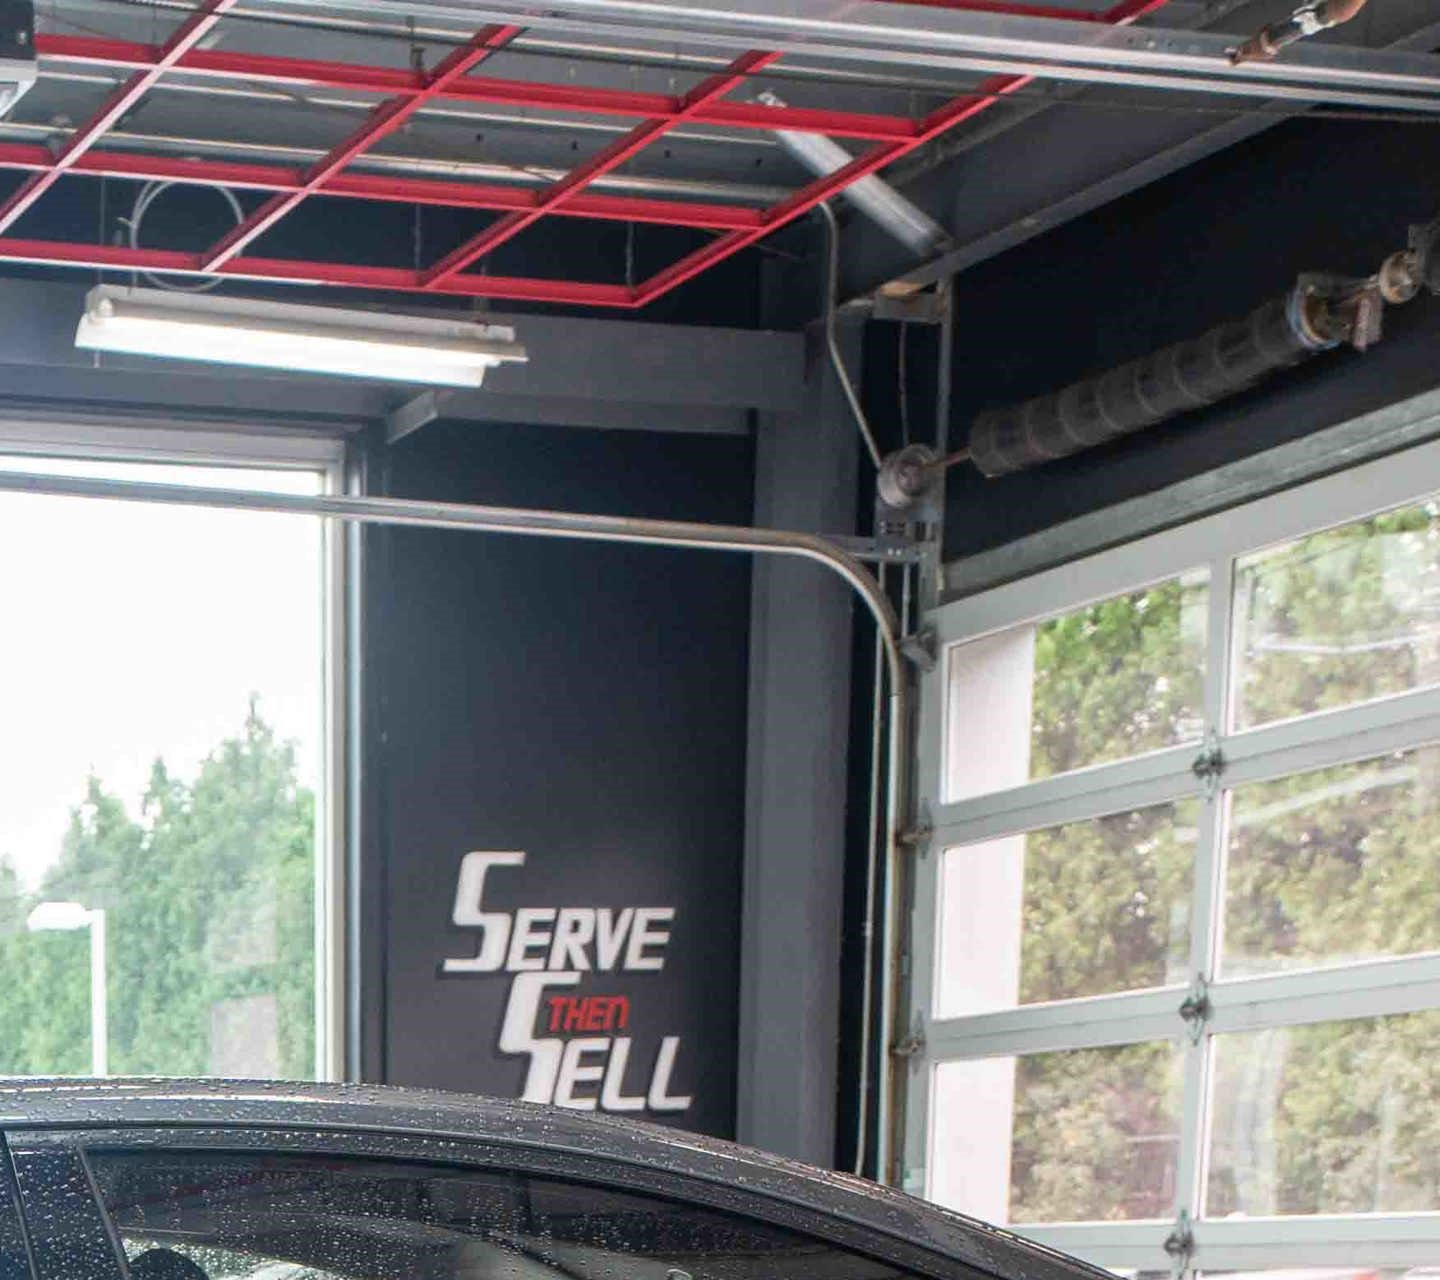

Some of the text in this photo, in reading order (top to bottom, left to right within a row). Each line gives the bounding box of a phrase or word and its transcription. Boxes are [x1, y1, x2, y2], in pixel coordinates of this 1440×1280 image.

[443, 851, 676, 972] SERVE
[498, 971, 693, 1111] SELL
[548, 995, 630, 1031] THEN
